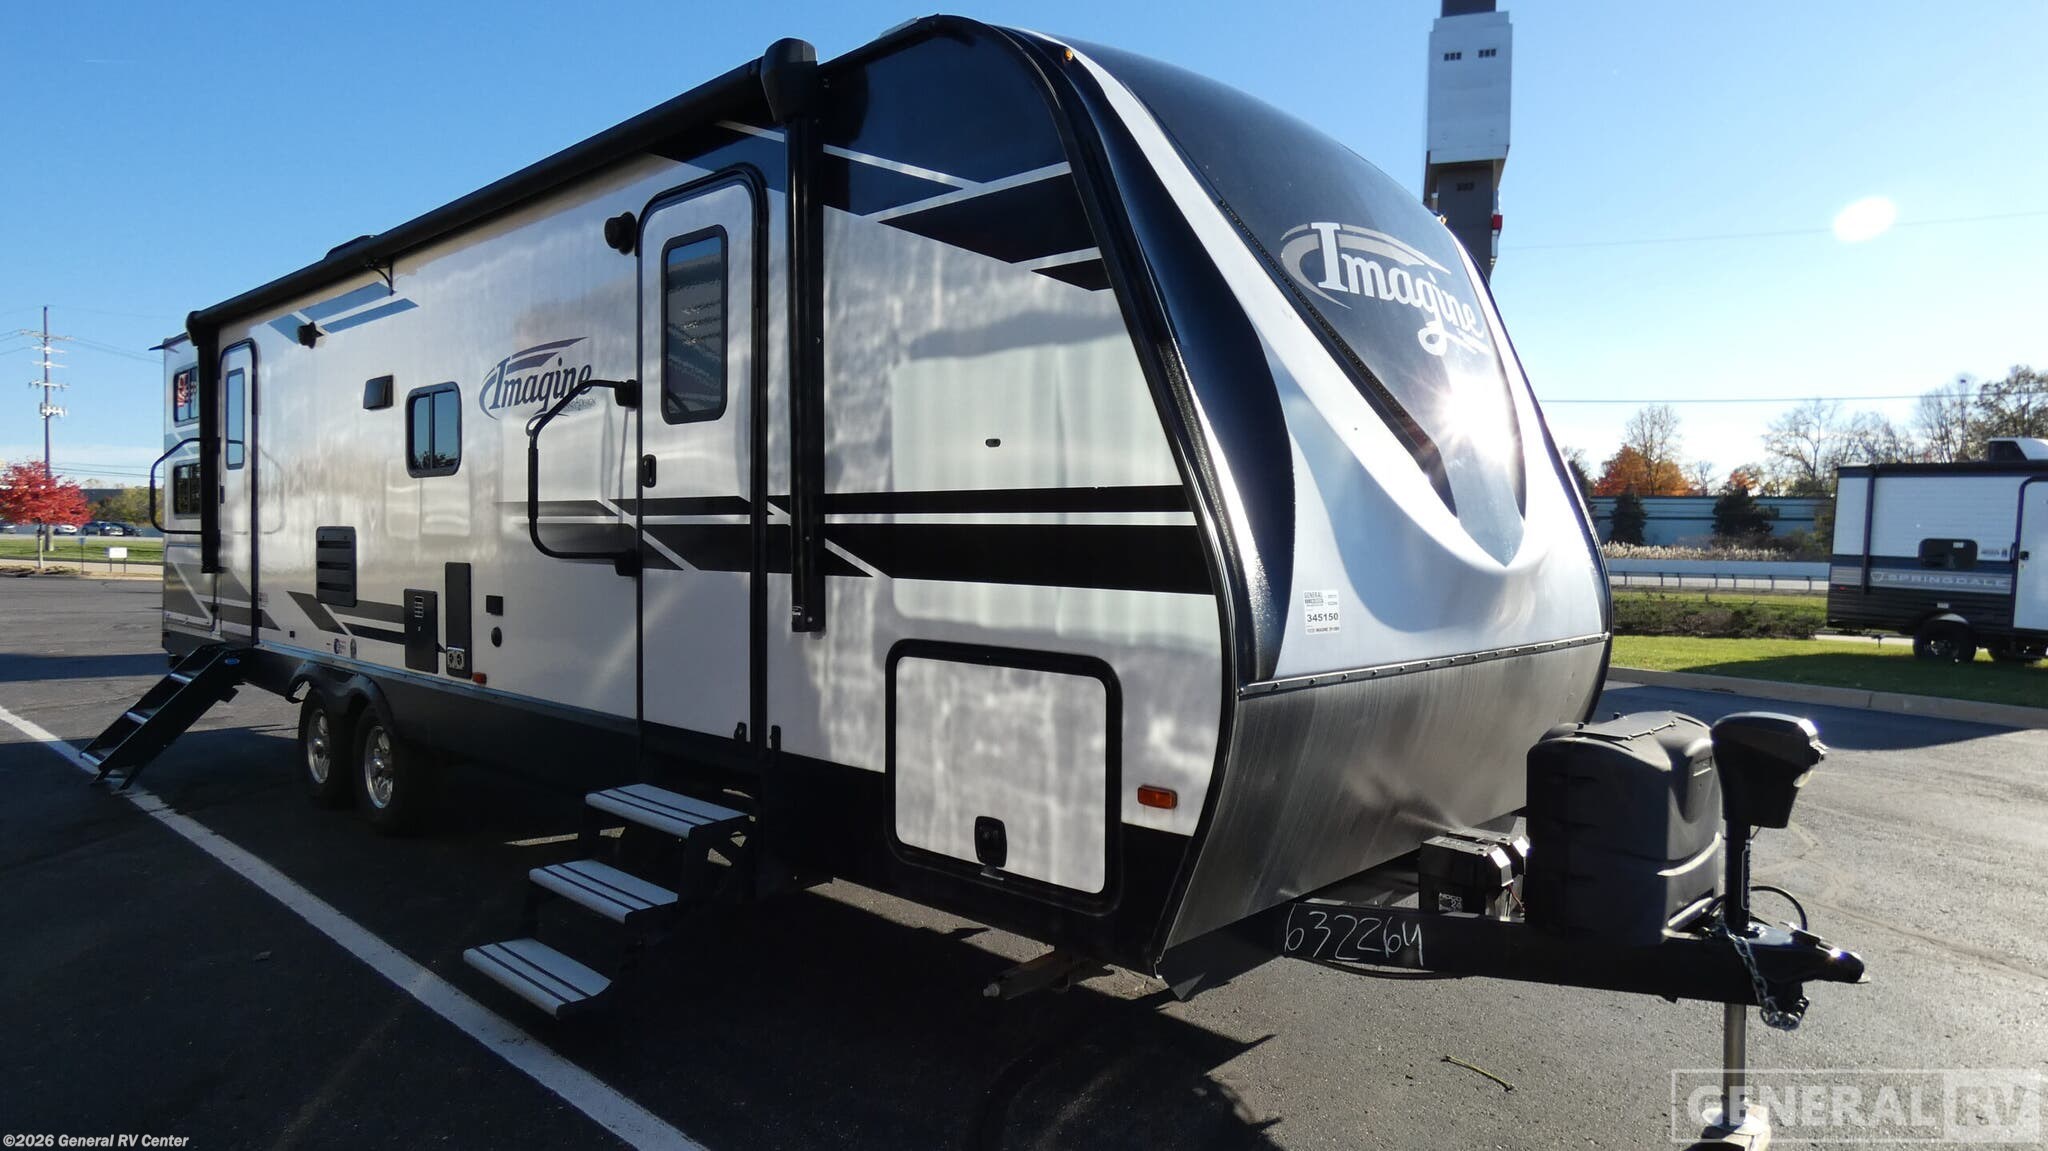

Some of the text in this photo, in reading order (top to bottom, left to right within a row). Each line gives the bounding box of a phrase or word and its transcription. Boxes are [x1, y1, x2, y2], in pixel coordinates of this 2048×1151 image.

[1310, 222, 1489, 357] Imagine
[489, 356, 592, 437] Imagine
[1888, 573, 2009, 588] SPRINGDALE
[1306, 613, 1339, 622] 345150
[1285, 903, 1424, 966] 632264
